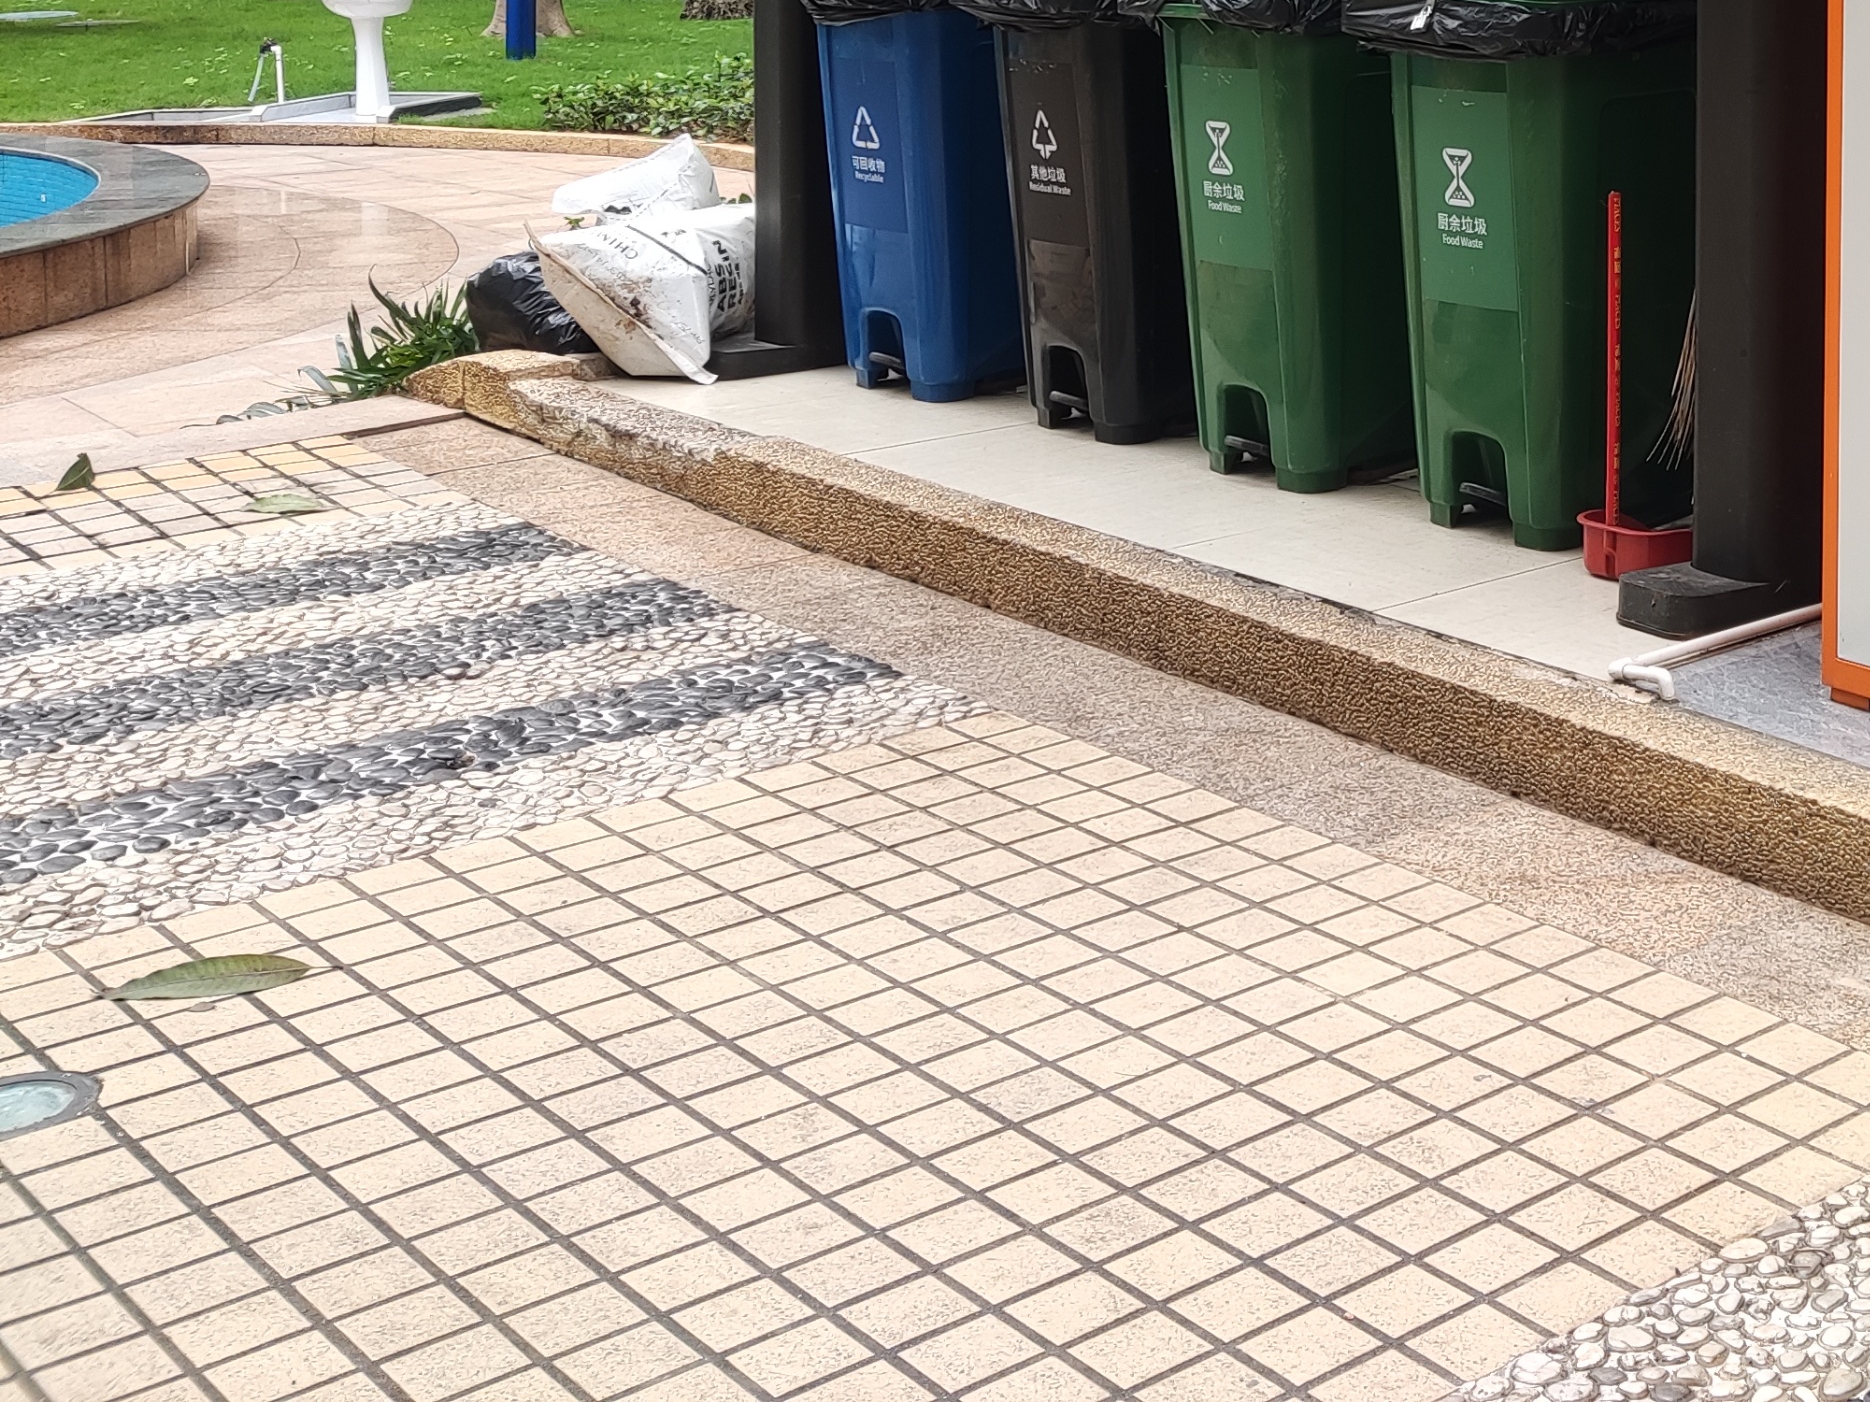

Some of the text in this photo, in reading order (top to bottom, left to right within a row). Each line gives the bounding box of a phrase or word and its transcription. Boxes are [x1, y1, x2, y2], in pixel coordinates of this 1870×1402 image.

[852, 155, 886, 174] 可回收物
[1030, 164, 1067, 183] 其他垃圾
[854, 170, 885, 184] Recyclable
[1202, 180, 1246, 203] 厨余垃圾
[1208, 200, 1242, 214] Food Waste
[1437, 211, 1488, 237] 厨余垃圾
[1442, 233, 1484, 250] Food Waste
[714, 262, 728, 312] ABS
